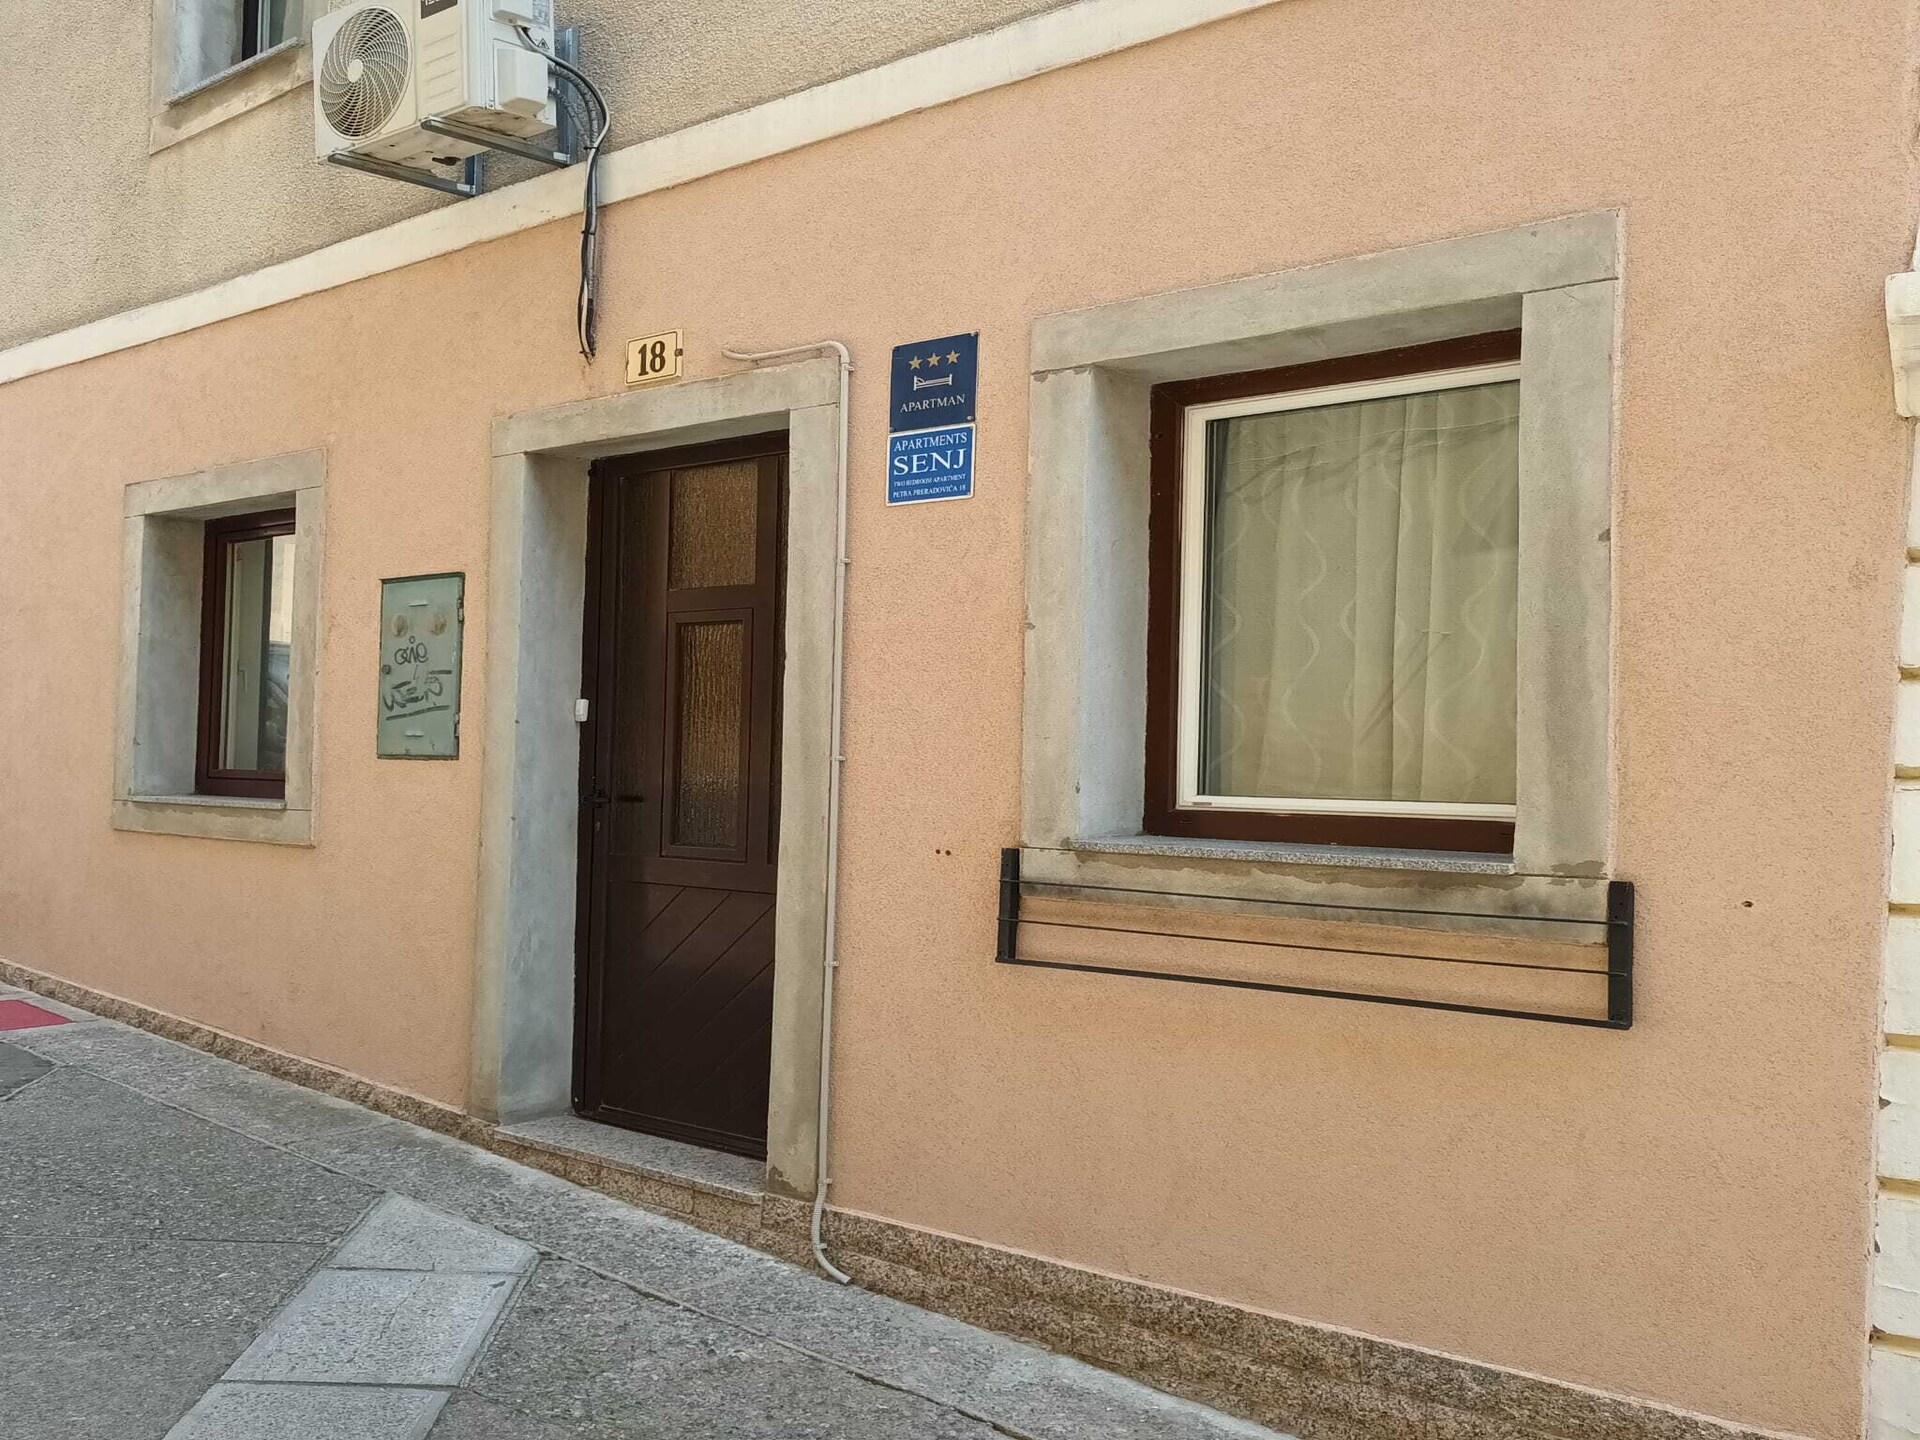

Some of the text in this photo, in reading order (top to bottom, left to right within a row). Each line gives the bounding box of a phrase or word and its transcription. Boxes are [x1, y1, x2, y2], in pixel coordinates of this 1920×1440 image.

[638, 340, 666, 377] 18
[900, 394, 965, 413] APARTMAN
[894, 432, 967, 452] APARTMENTS
[894, 448, 967, 476] SENJ
[906, 478, 933, 486] BEDROOM
[933, 474, 966, 484] APARTMENT
[892, 490, 912, 499] PETRA
